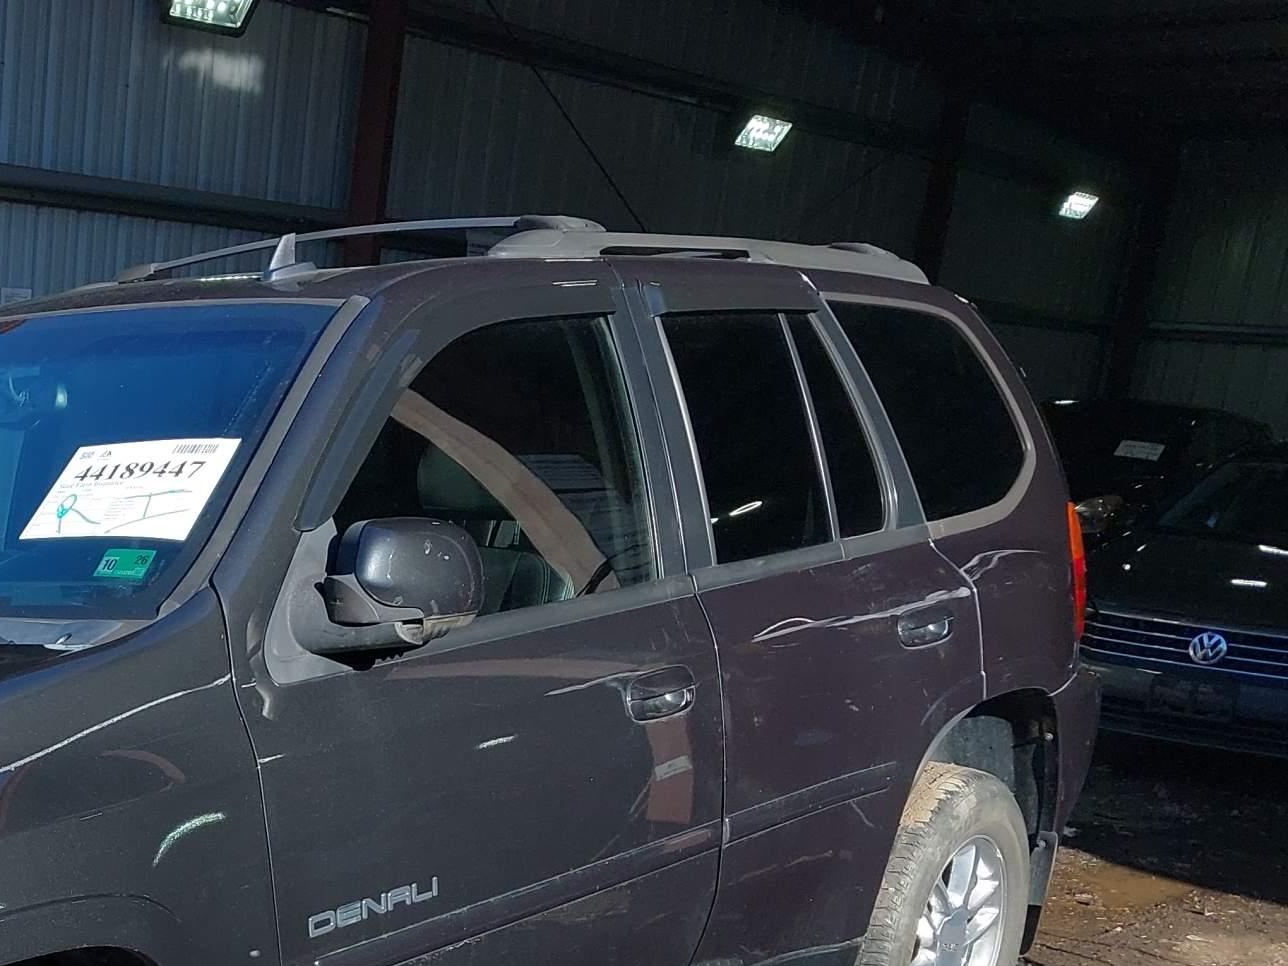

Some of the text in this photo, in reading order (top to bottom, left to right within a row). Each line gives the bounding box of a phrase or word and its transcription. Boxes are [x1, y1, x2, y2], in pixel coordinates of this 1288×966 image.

[75, 461, 206, 481] 44189447
[102, 558, 118, 571] 10
[133, 554, 150, 566] 26
[308, 876, 439, 938] DENALI
